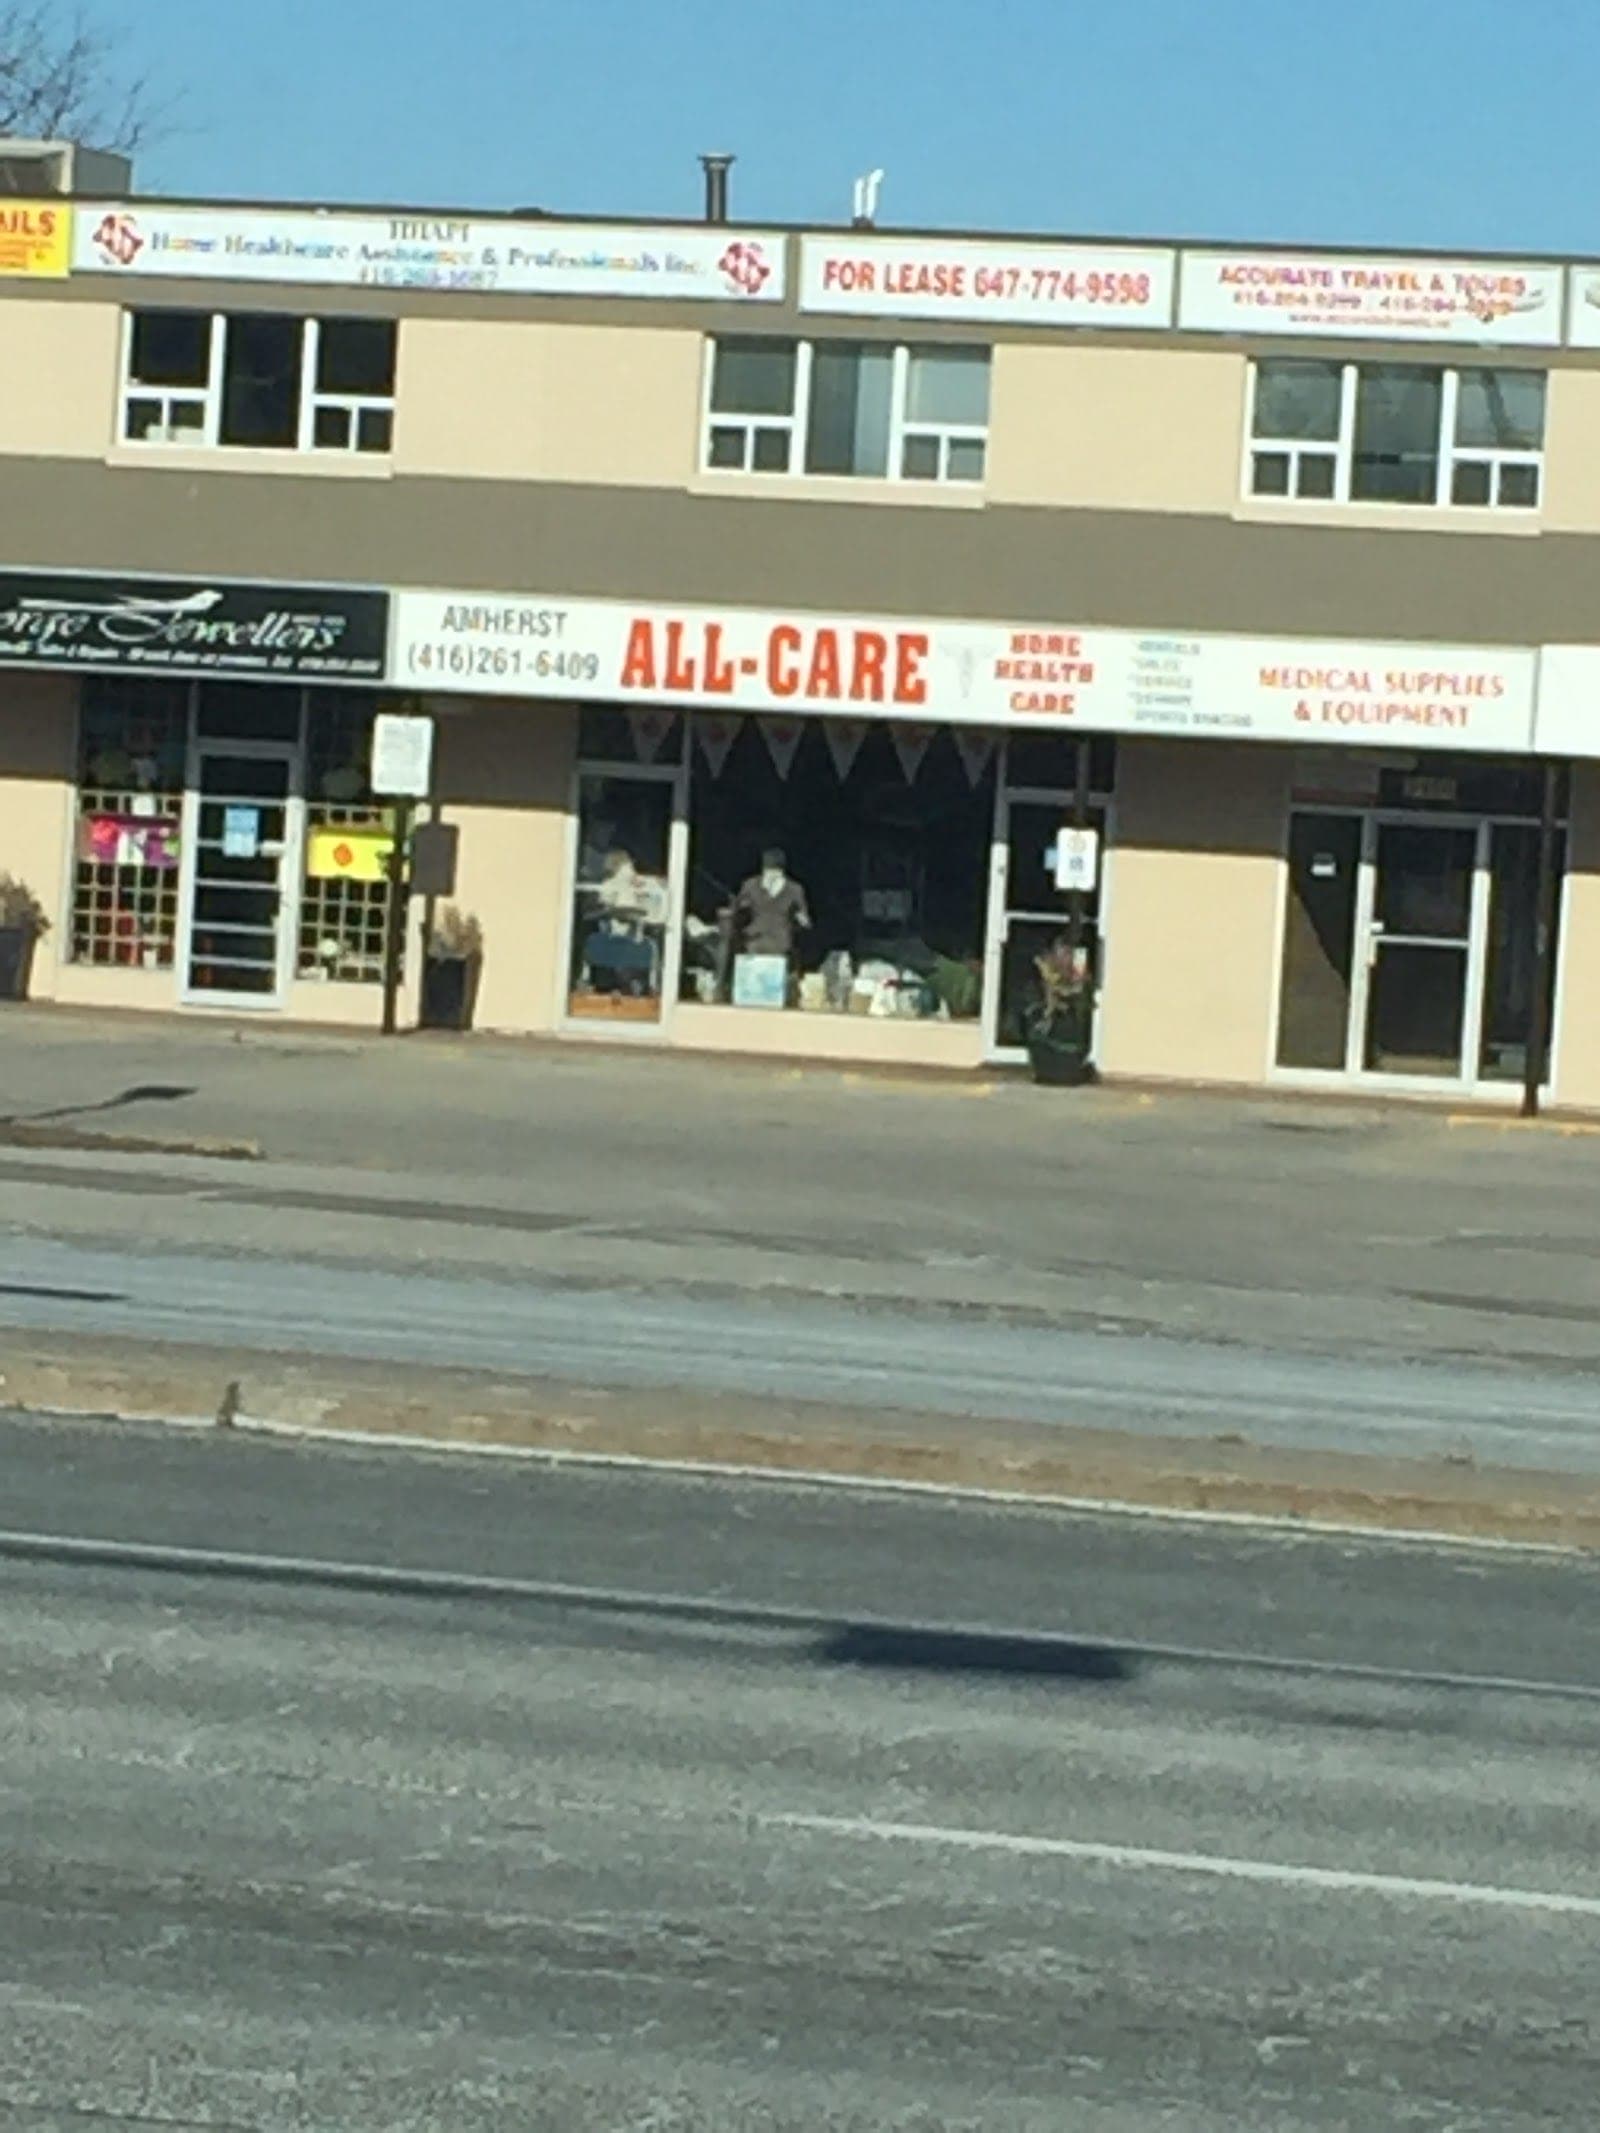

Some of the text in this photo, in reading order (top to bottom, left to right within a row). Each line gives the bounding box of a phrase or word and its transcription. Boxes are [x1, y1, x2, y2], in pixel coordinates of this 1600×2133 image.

[481, 247, 497, 265] &
[823, 260, 1150, 303] FOR LEASE 647-774-9598
[1219, 265, 1334, 288] ACCURATE
[1341, 270, 1421, 292] TRAVEL
[441, 605, 567, 637] AMHERST
[1011, 634, 1081, 657] HOME
[408, 643, 599, 680] (416)261-6409
[620, 619, 930, 706] ALL-CARE
[995, 659, 1094, 683] HEALTH
[1258, 667, 1504, 698] MEDICAL SUPPLIES
[1009, 690, 1075, 715] CARE
[1294, 699, 1469, 727] & EQUIPMENT
